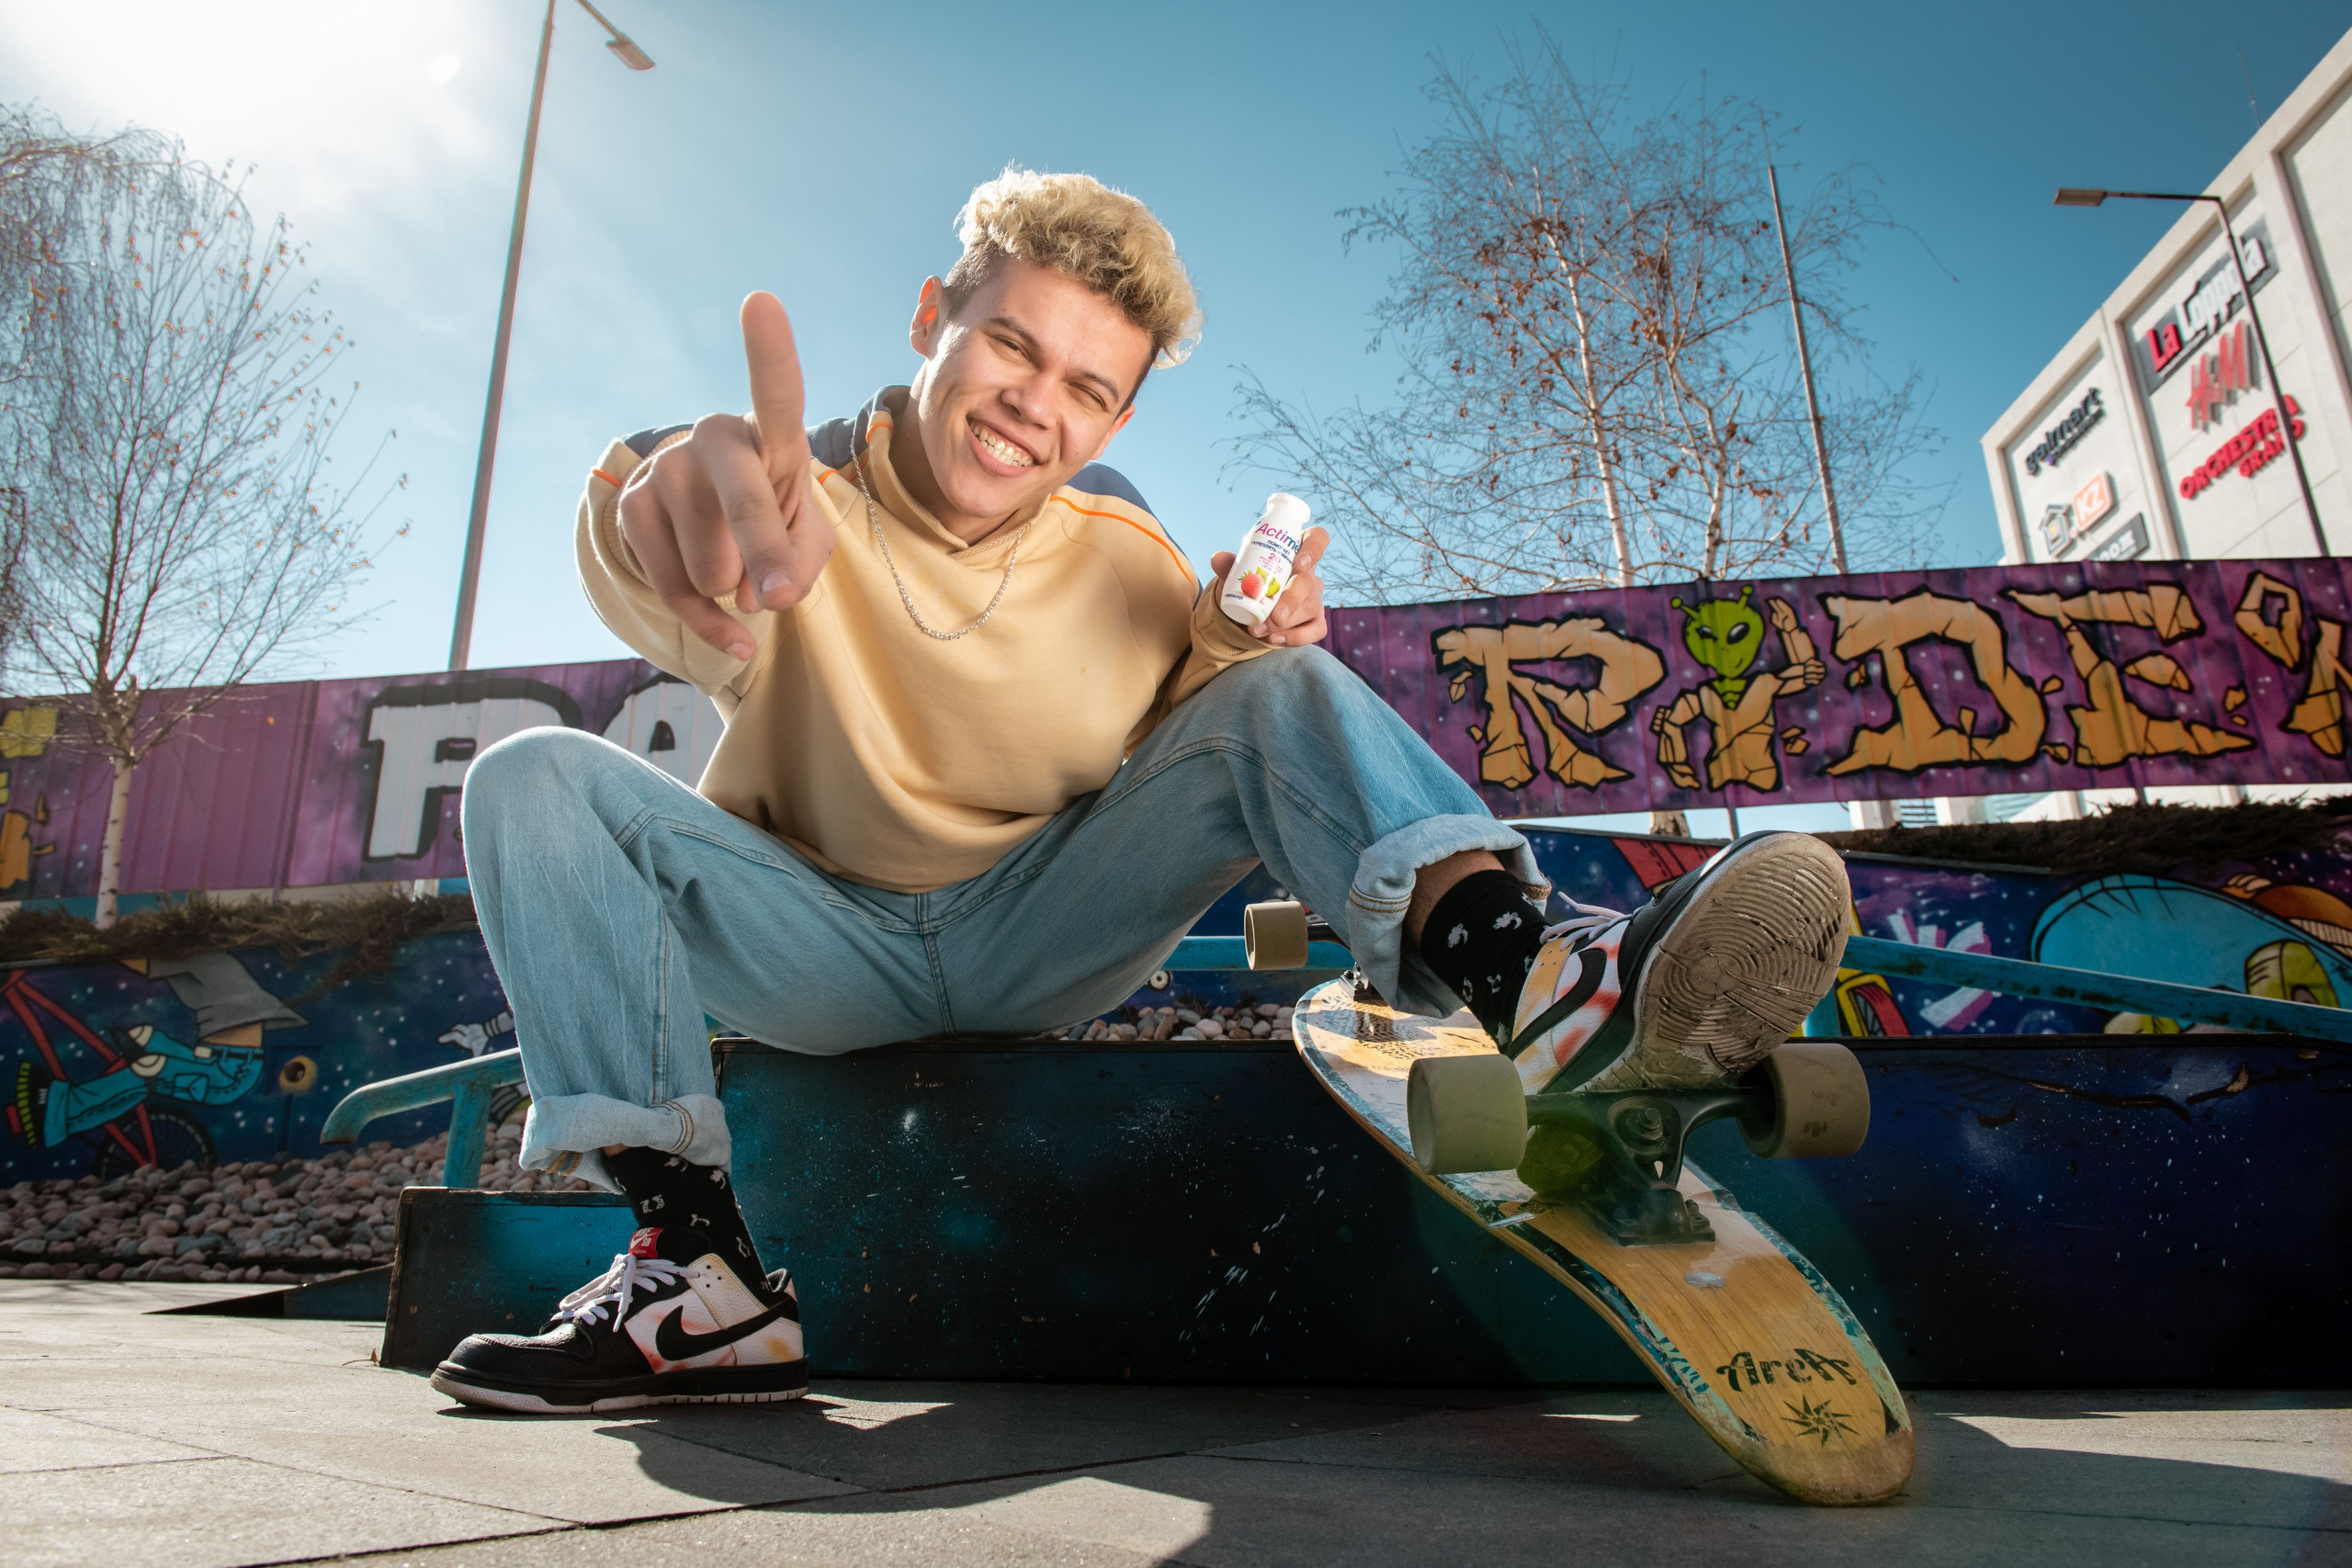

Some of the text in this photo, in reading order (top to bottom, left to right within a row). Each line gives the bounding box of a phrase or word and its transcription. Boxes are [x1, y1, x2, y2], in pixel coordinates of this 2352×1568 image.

[2146, 323, 2182, 373] La
[2186, 320, 2245, 430] H&M
[2026, 388, 2100, 476] galmart
[1255, 523, 1300, 555] Actime
